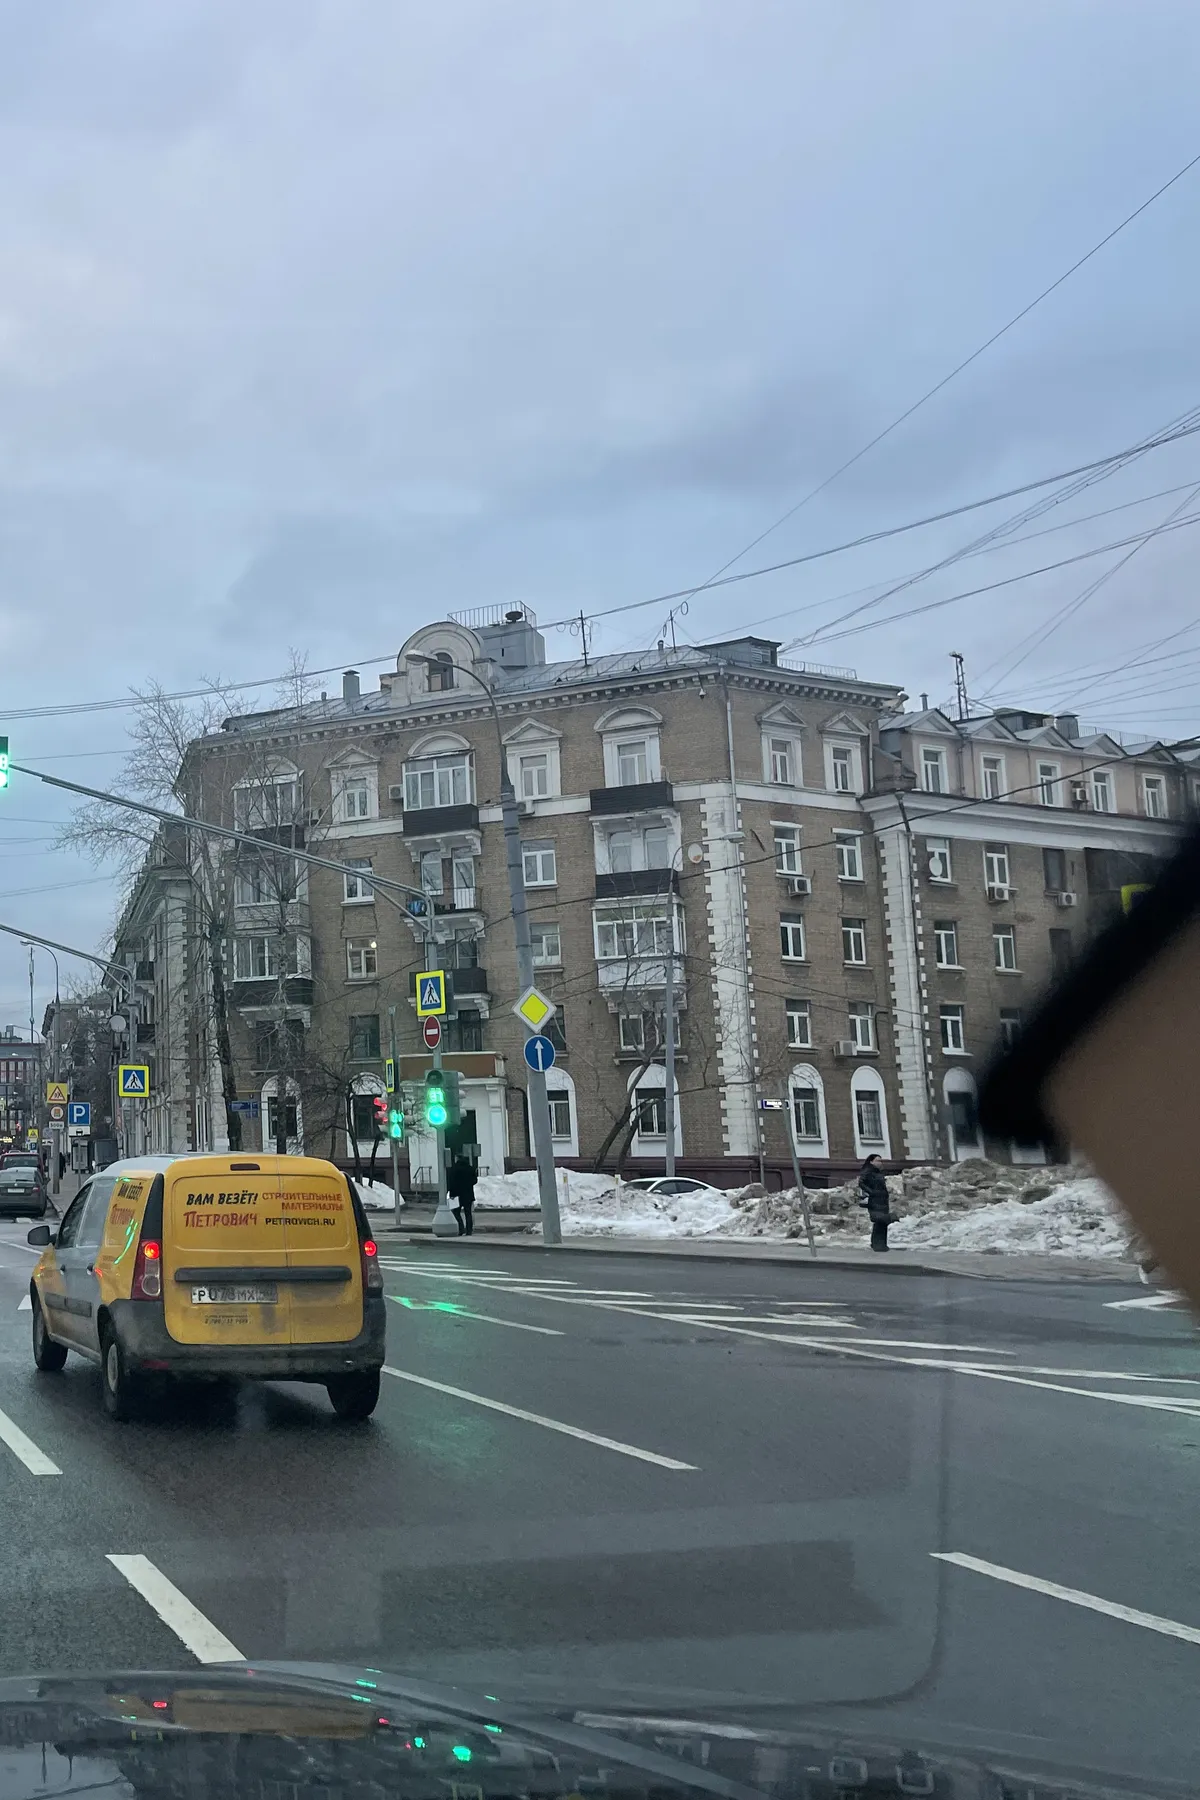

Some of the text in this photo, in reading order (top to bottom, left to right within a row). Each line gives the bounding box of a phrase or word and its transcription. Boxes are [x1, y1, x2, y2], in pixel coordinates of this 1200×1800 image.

[73, 1105, 85, 1122] P
[186, 1190, 259, 1205] ВАМ ВЕЗЁТ!
[262, 1192, 343, 1201] СТРОИТЕЛЬНЫЕ
[281, 1202, 344, 1211] МАТЕРИАЛЫ
[183, 1211, 258, 1228] ПЕТРОВИЧ
[265, 1217, 336, 1226] PETROVICH.RU
